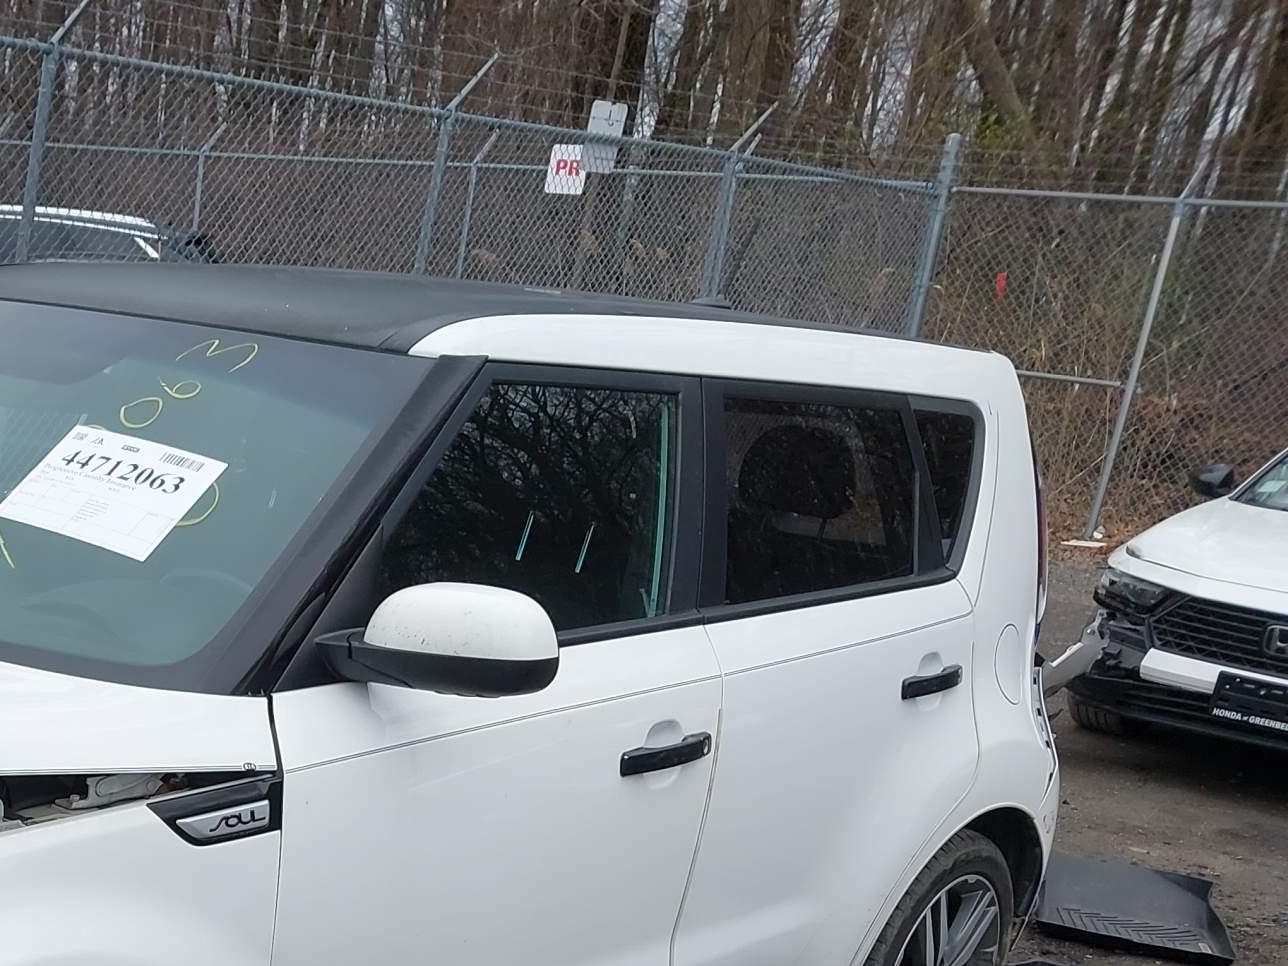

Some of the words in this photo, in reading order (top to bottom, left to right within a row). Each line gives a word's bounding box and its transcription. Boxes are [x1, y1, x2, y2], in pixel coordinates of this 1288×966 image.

[555, 159, 581, 176] PR
[61, 449, 186, 495] 44712063
[1212, 707, 1242, 721] HONDA
[209, 809, 266, 832] SOUL
